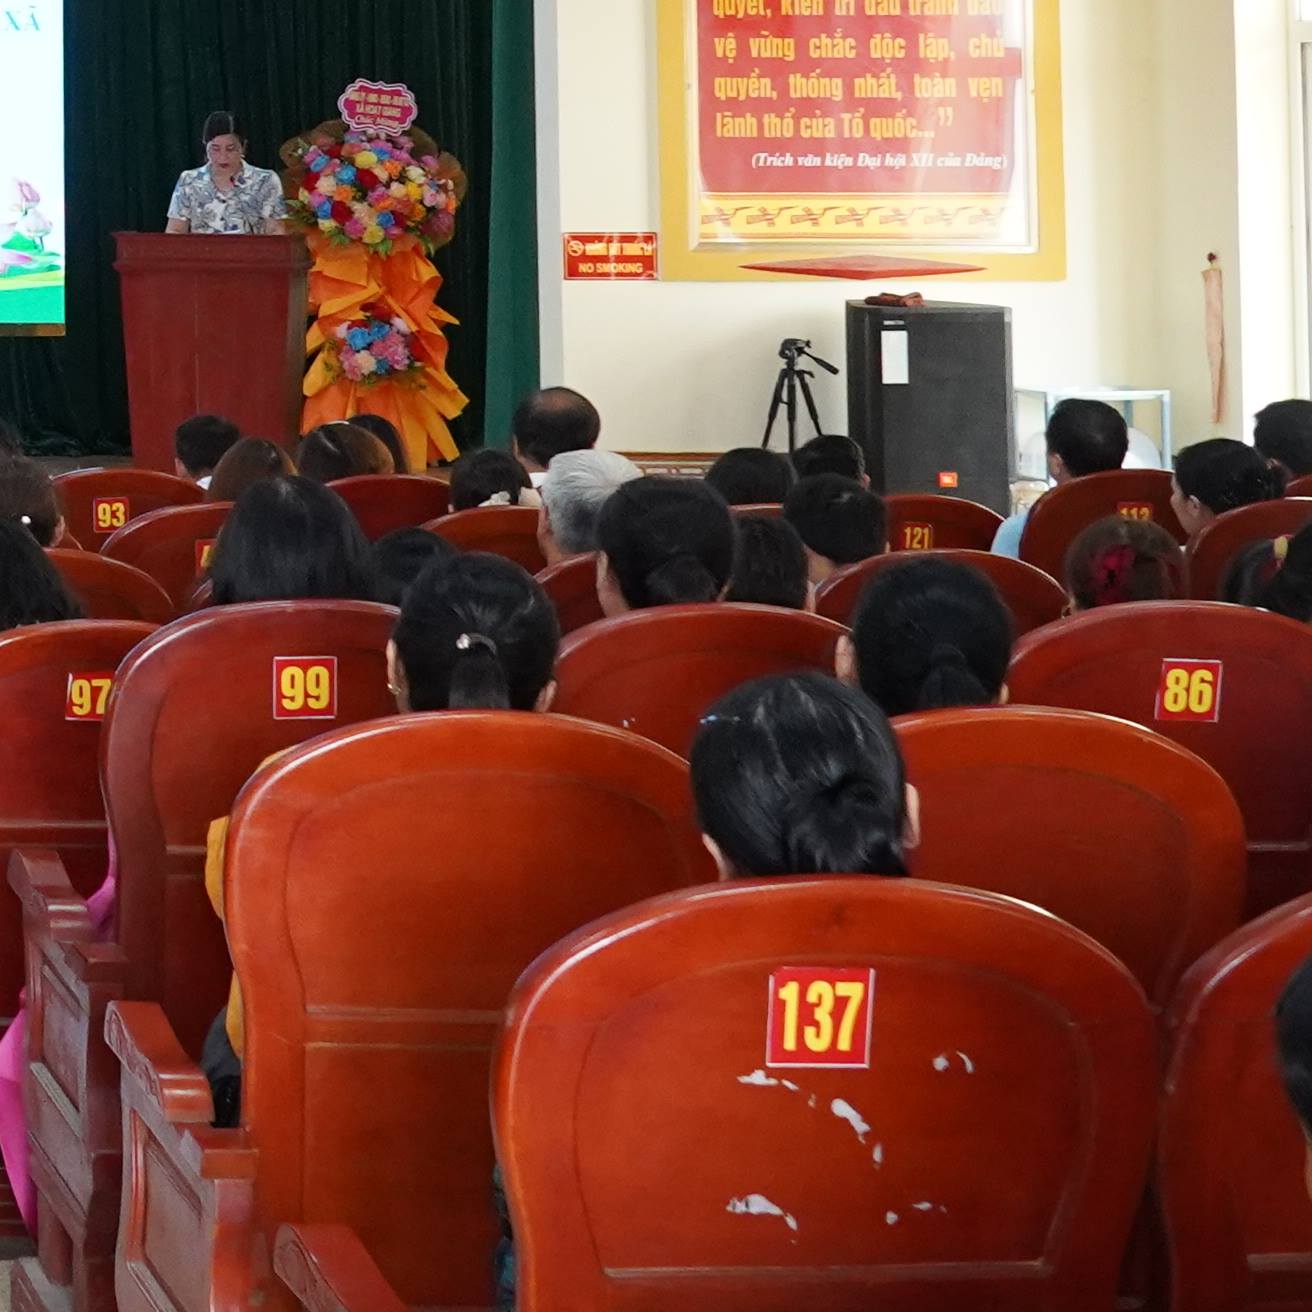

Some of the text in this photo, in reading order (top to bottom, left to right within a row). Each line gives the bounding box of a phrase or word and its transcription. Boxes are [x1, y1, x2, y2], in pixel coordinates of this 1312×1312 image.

[97, 502, 126, 528] 93
[904, 527, 929, 550] 121
[72, 679, 111, 715] 97
[280, 666, 330, 711] 99
[1163, 669, 1214, 713] 86
[778, 980, 864, 1053] 137
